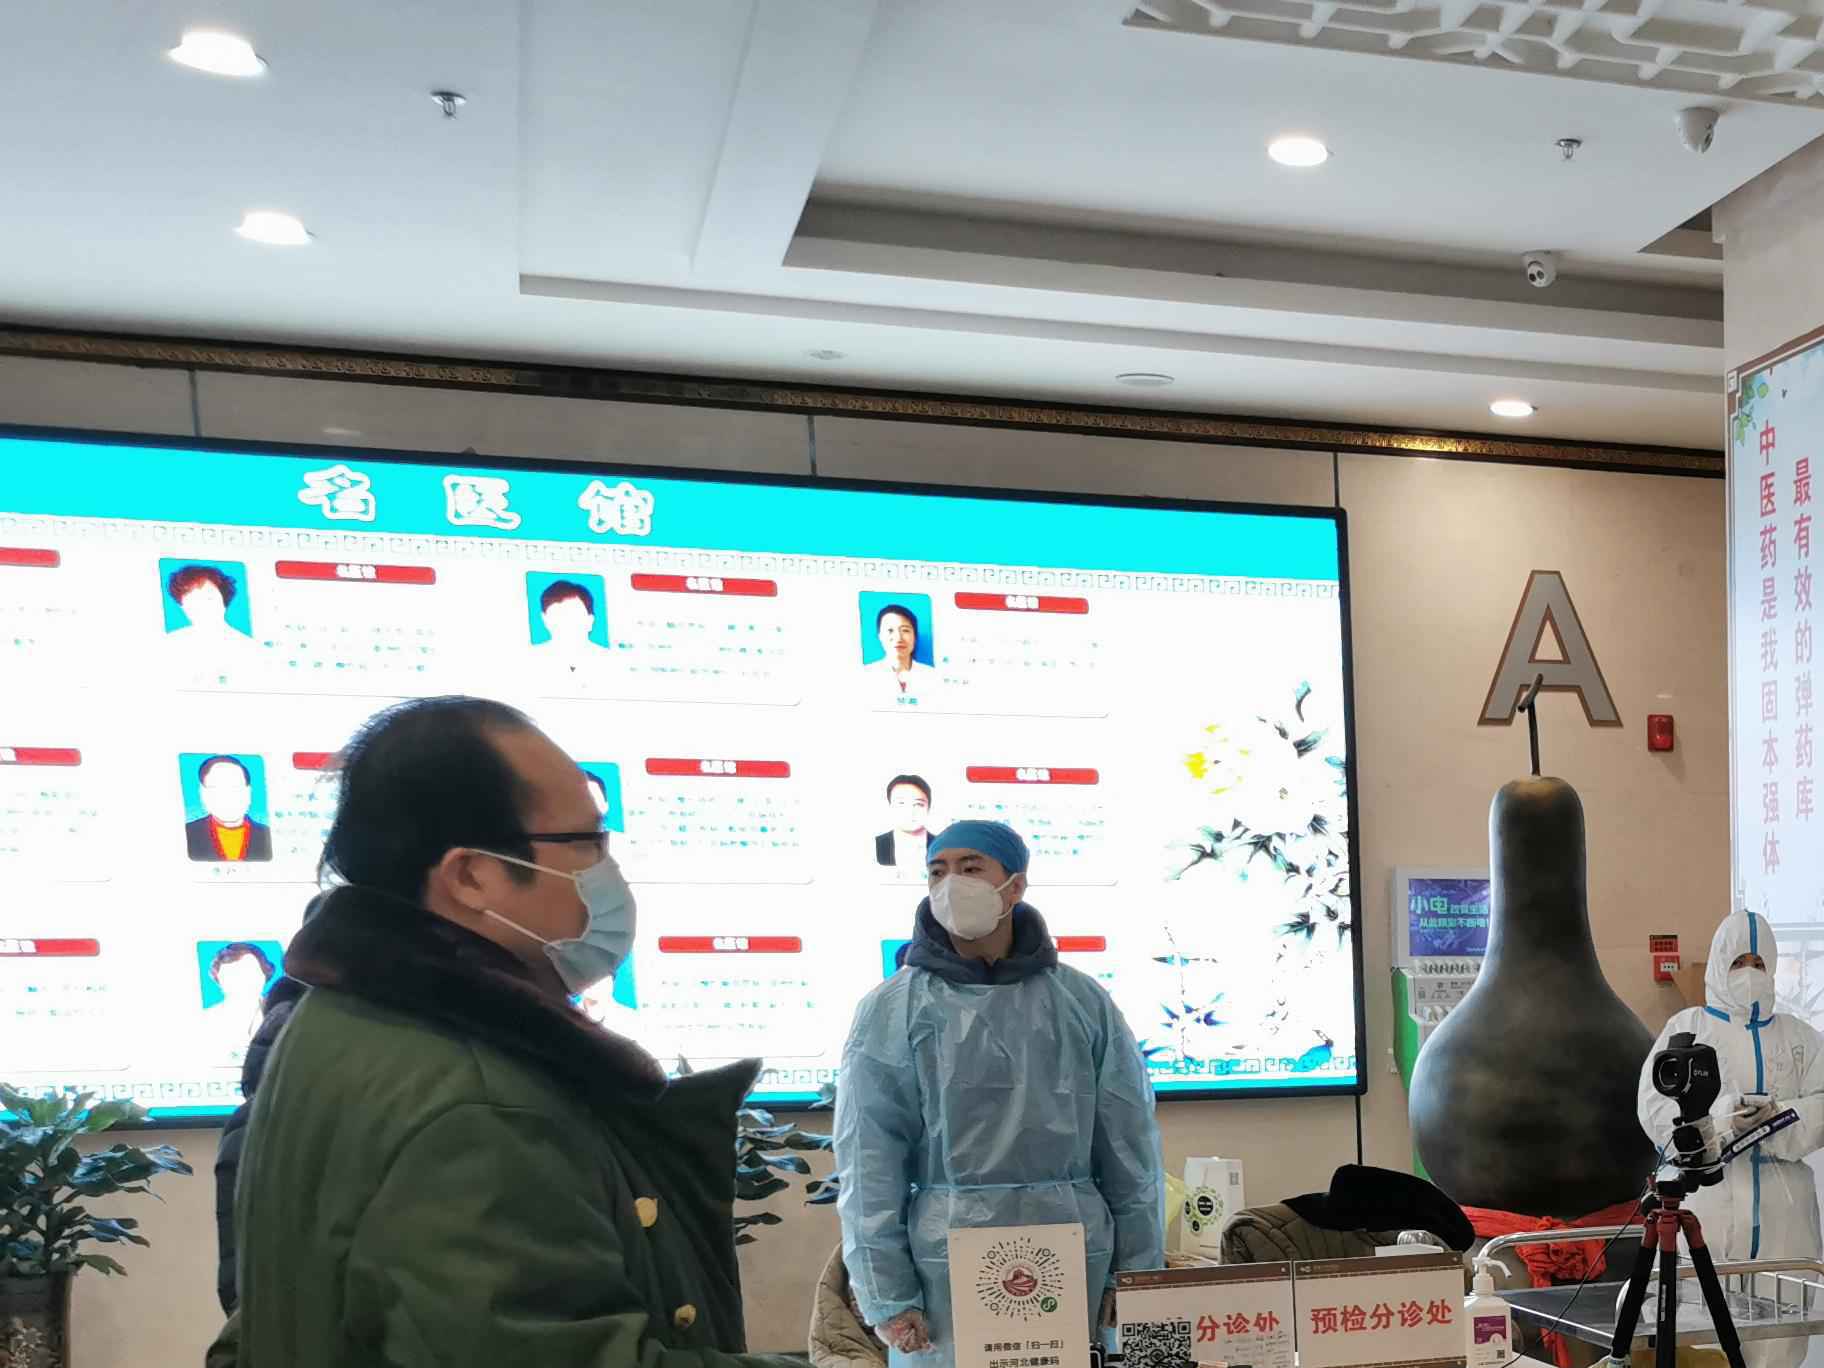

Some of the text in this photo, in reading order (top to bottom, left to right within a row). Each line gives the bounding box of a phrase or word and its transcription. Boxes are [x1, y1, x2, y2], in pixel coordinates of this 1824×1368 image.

[1477, 569, 1624, 729] A
[1759, 420, 1781, 876] 中医药是我固本强体
[1793, 456, 1815, 822] 最有效的弹药库
[1310, 1298, 1454, 1335] 预检分诊处
